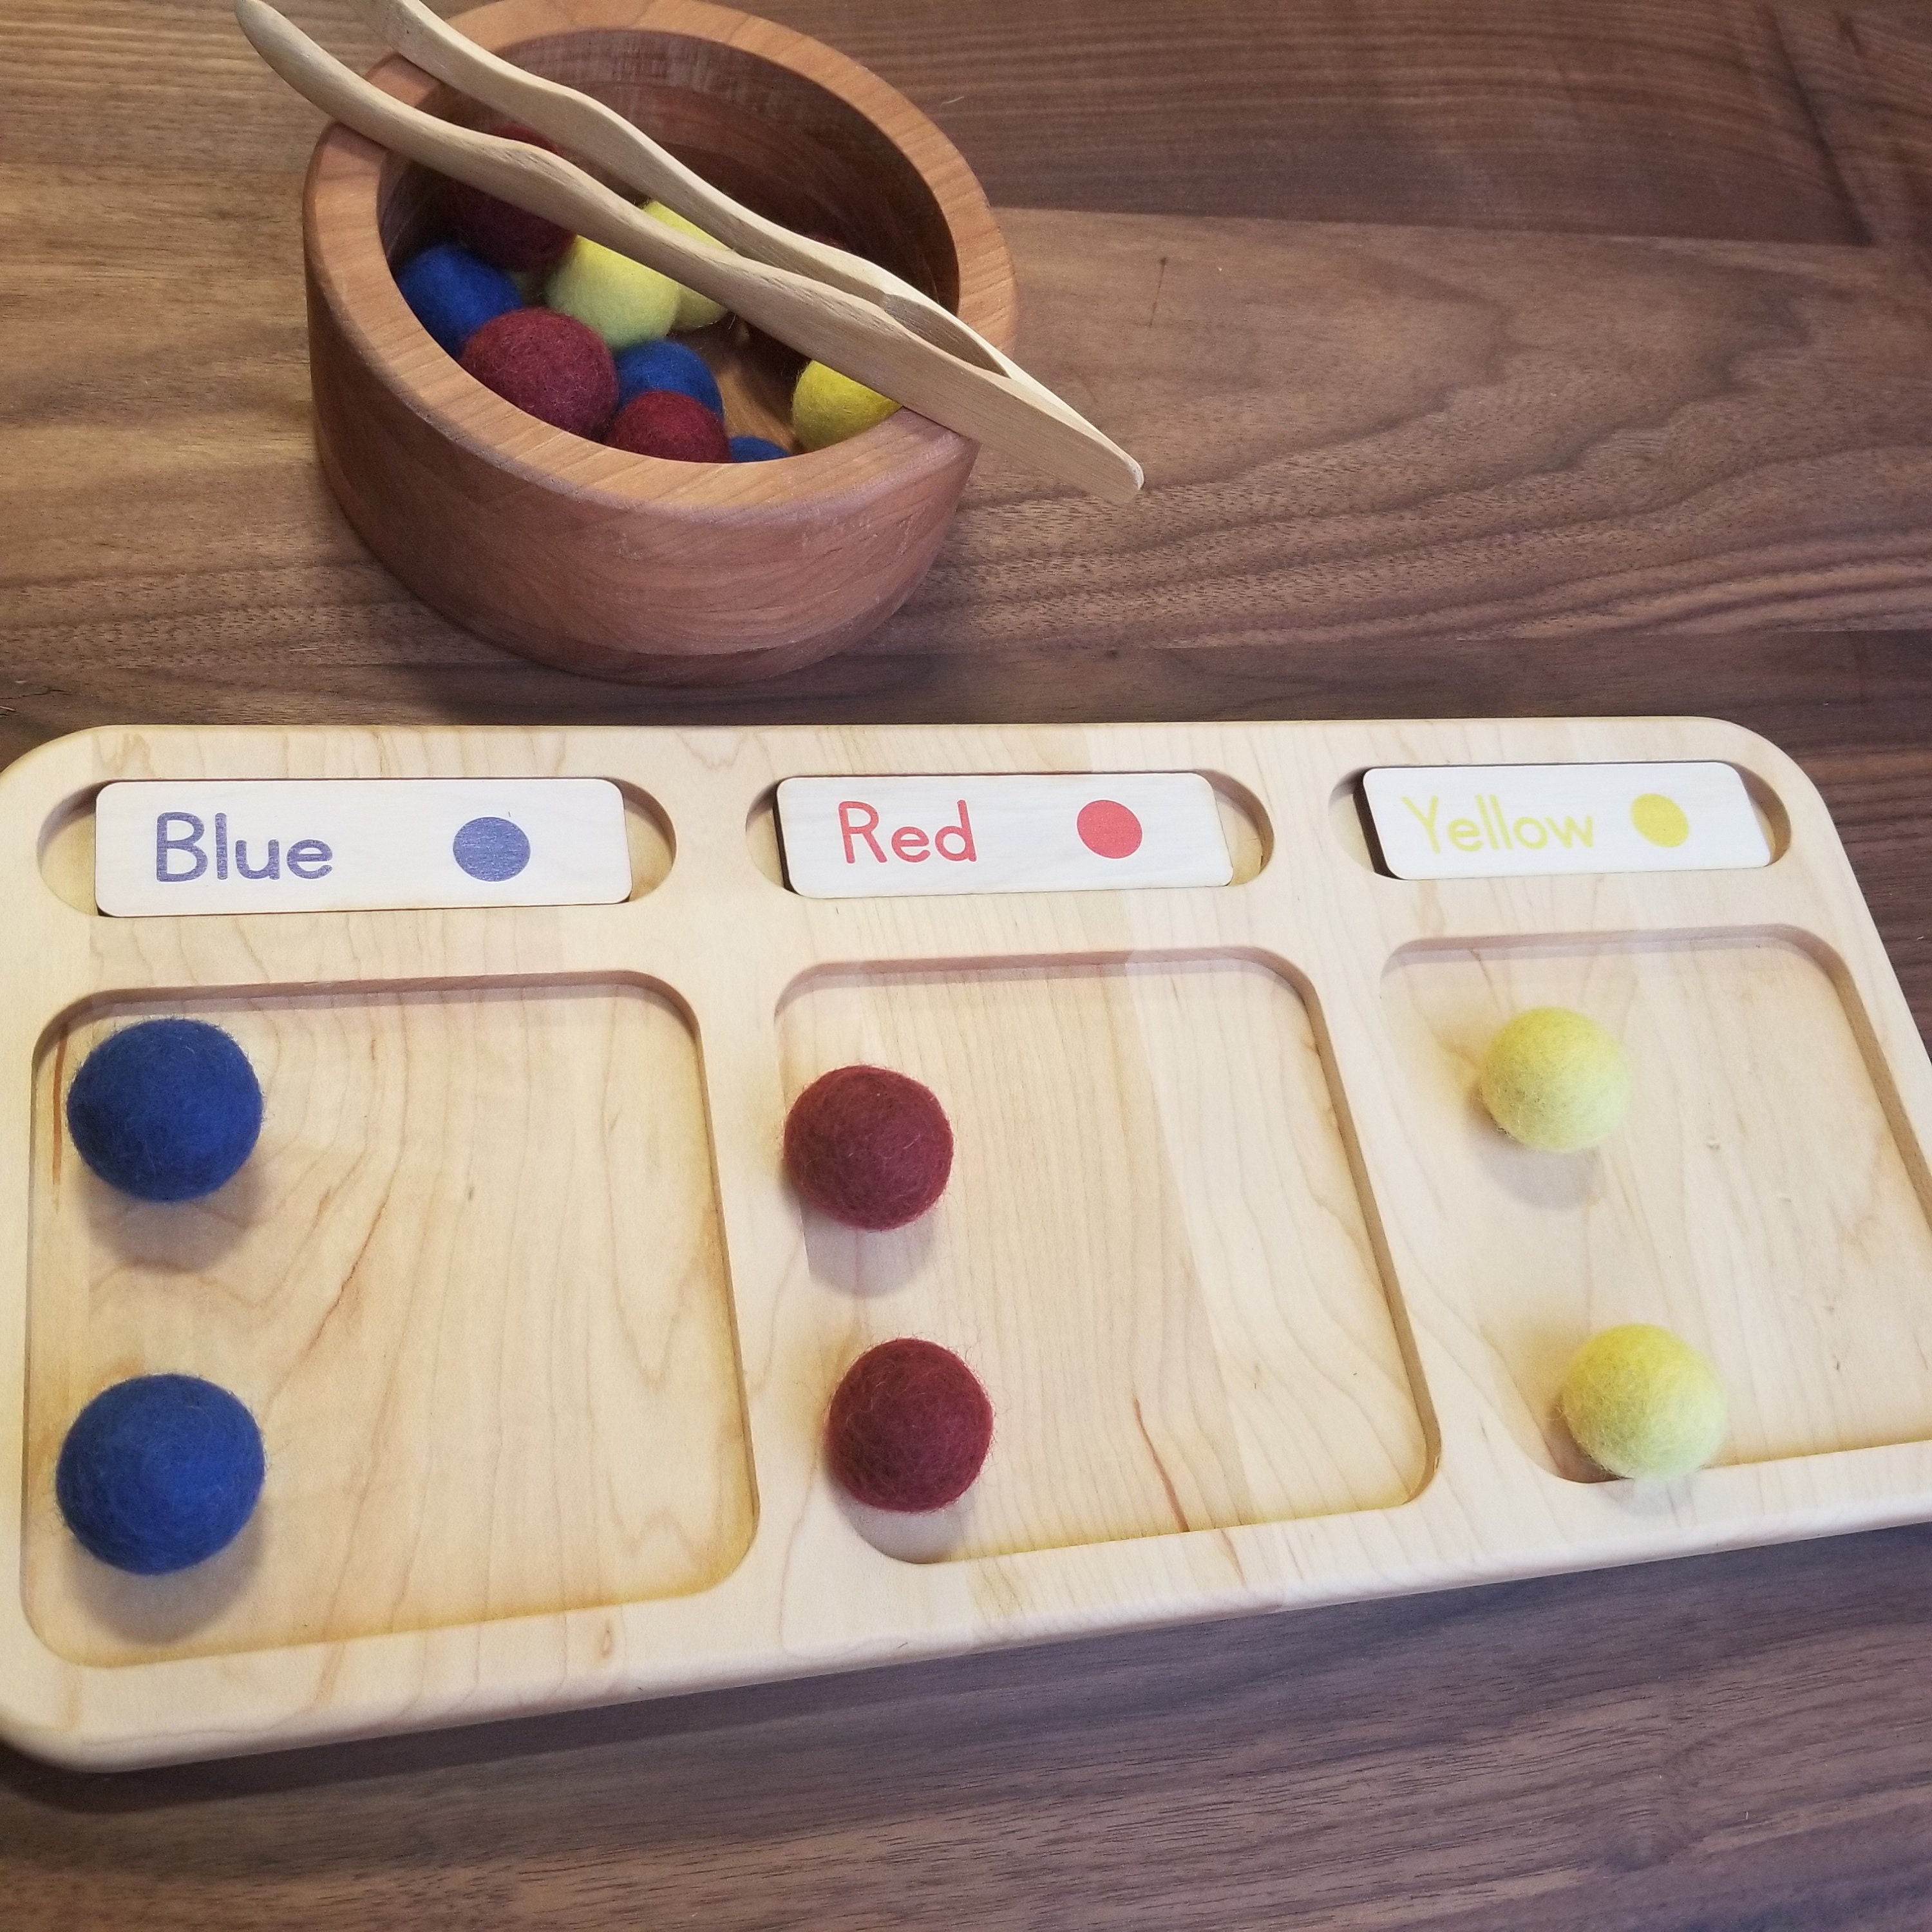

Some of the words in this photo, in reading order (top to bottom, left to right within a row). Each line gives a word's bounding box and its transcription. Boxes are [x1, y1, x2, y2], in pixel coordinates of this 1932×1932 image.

[156, 812, 334, 882] Blue
[838, 800, 976, 864] Red
[1403, 795, 1593, 852] Yellow
